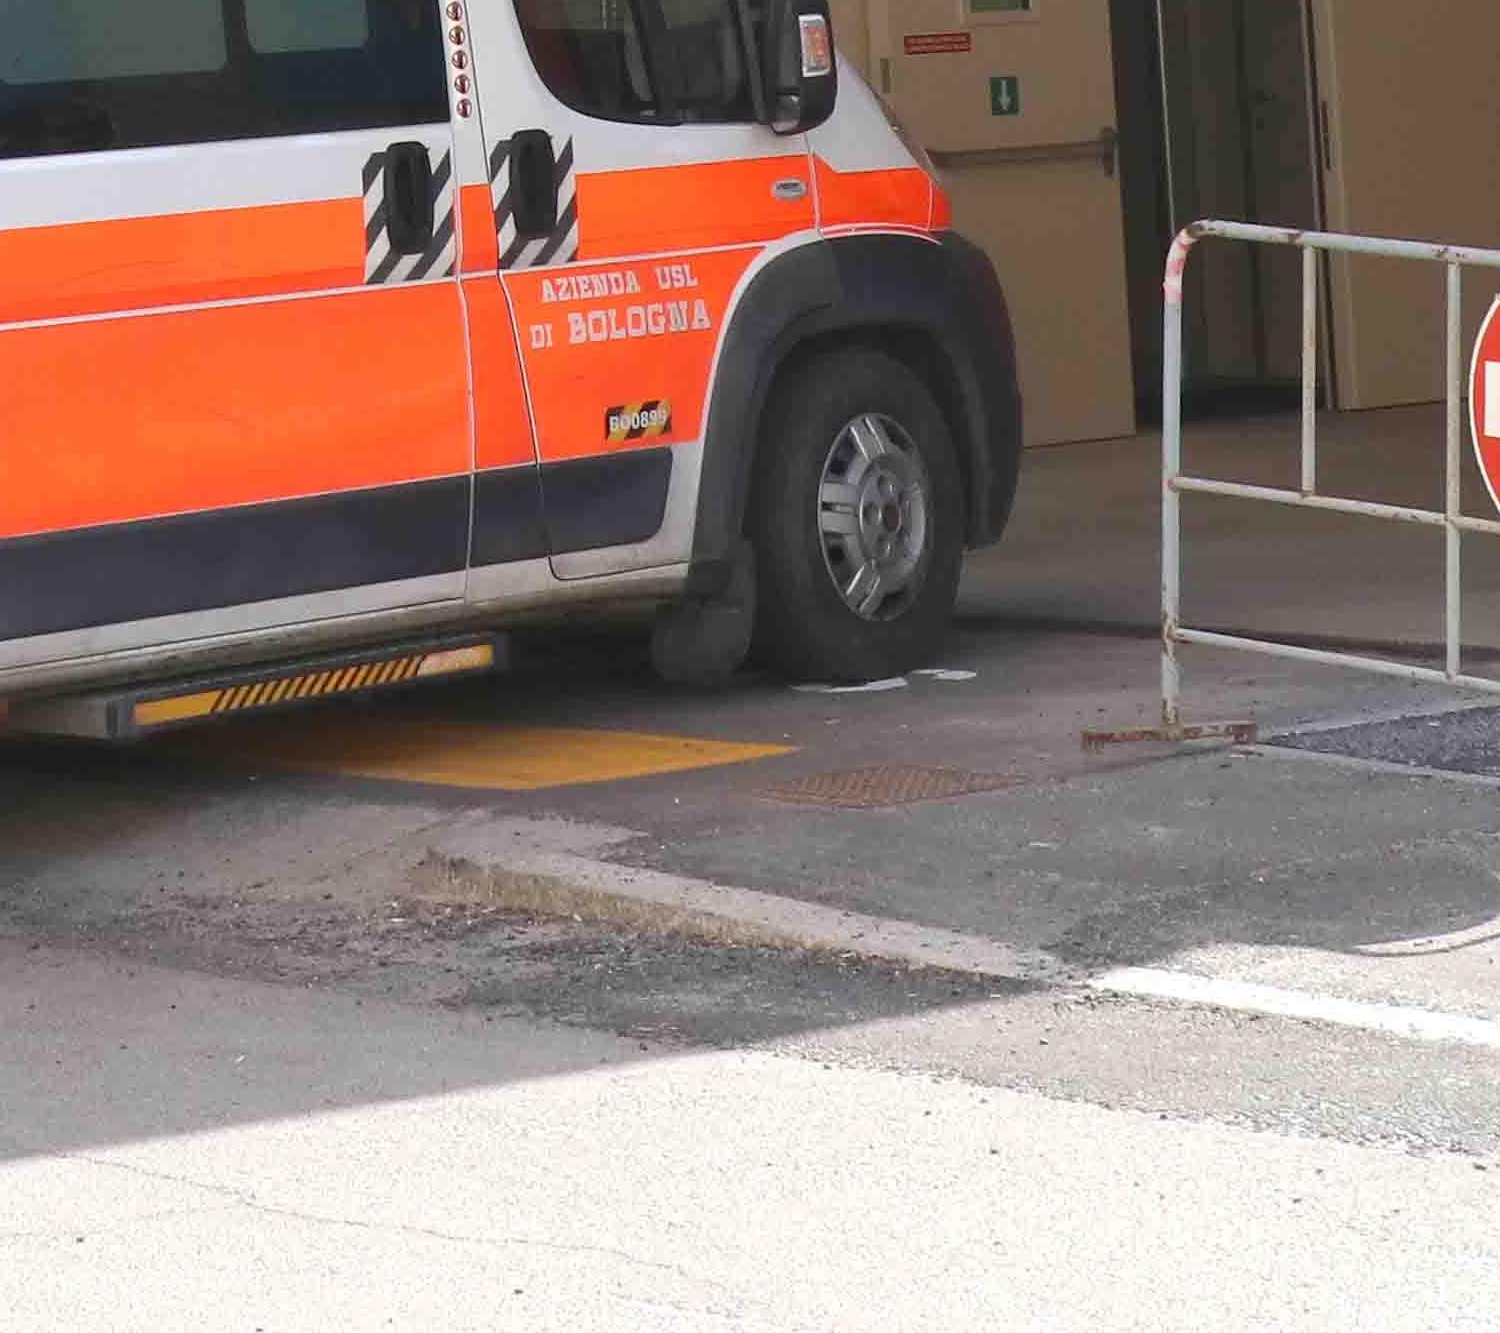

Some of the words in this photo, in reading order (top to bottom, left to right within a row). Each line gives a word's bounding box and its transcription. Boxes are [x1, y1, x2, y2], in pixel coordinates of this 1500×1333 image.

[541, 270, 641, 302] AZIENDA
[655, 262, 698, 290] USL
[529, 323, 553, 349] DI
[568, 298, 712, 345] BOLOGNA
